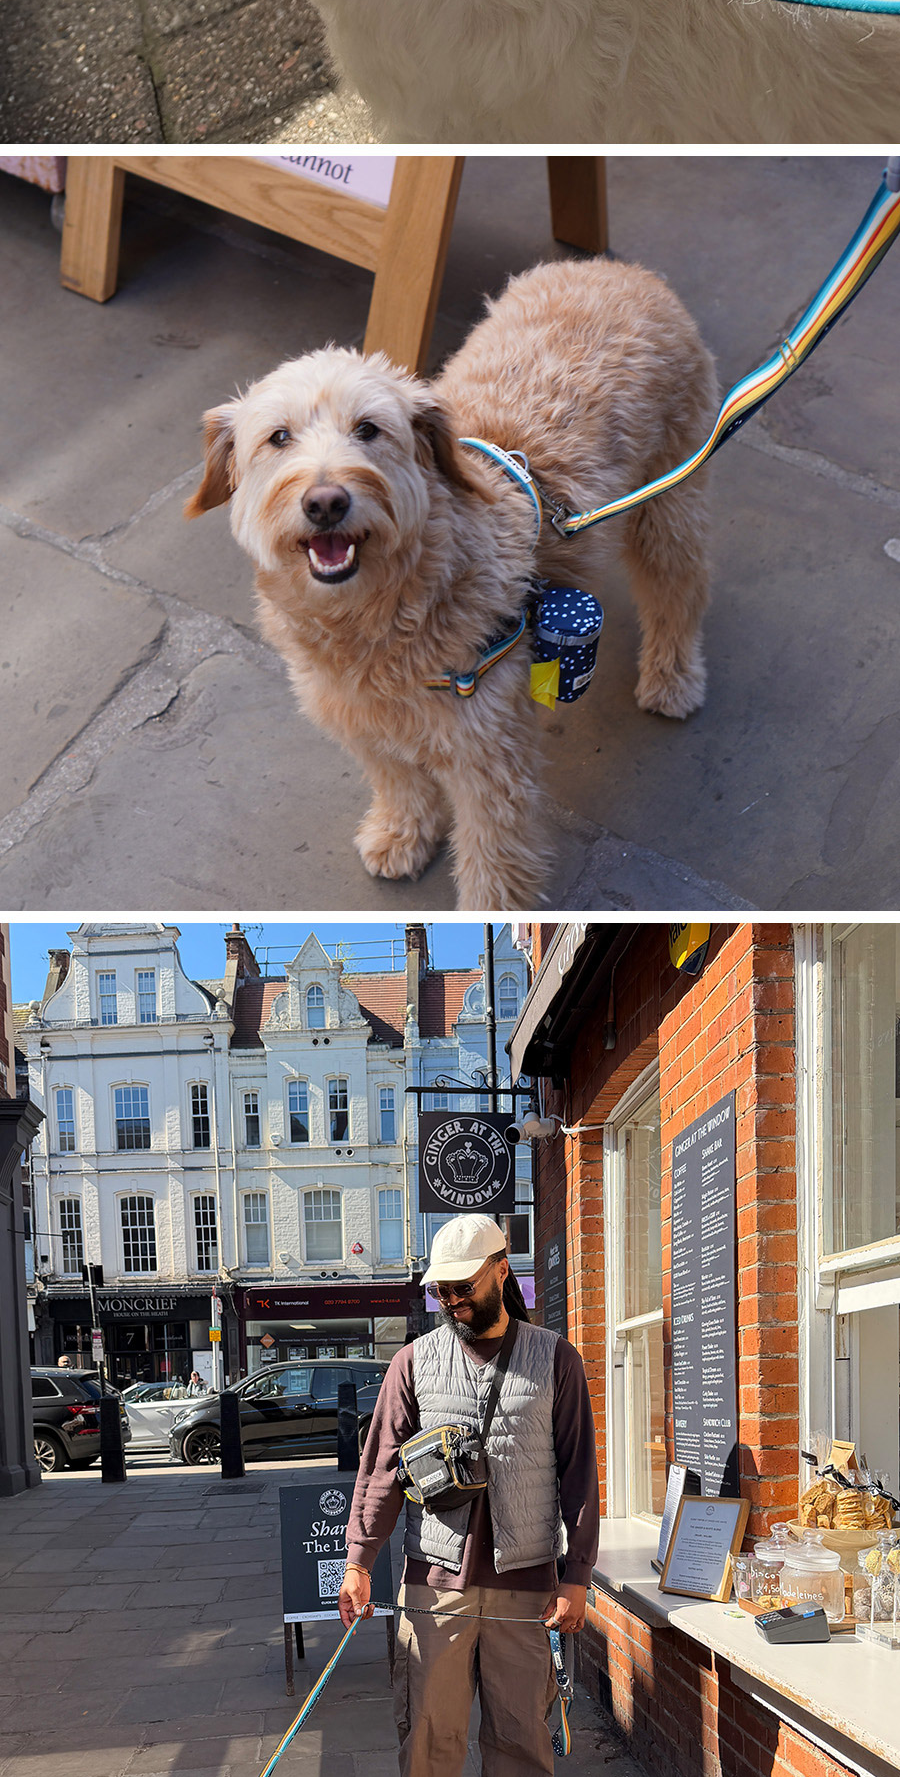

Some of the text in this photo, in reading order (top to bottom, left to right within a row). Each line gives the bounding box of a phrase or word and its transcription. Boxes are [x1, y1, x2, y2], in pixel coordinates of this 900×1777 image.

[280, 156, 354, 184] annot
[707, 1105, 731, 1133] WINDOW
[426, 1121, 506, 1166] GINGER AT THE
[440, 1184, 494, 1206] WINDOW
[97, 1298, 177, 1312] MONCRIEF
[126, 1332, 135, 1345] 7
[310, 1520, 347, 1538] Shar
[302, 1540, 331, 1554] The
